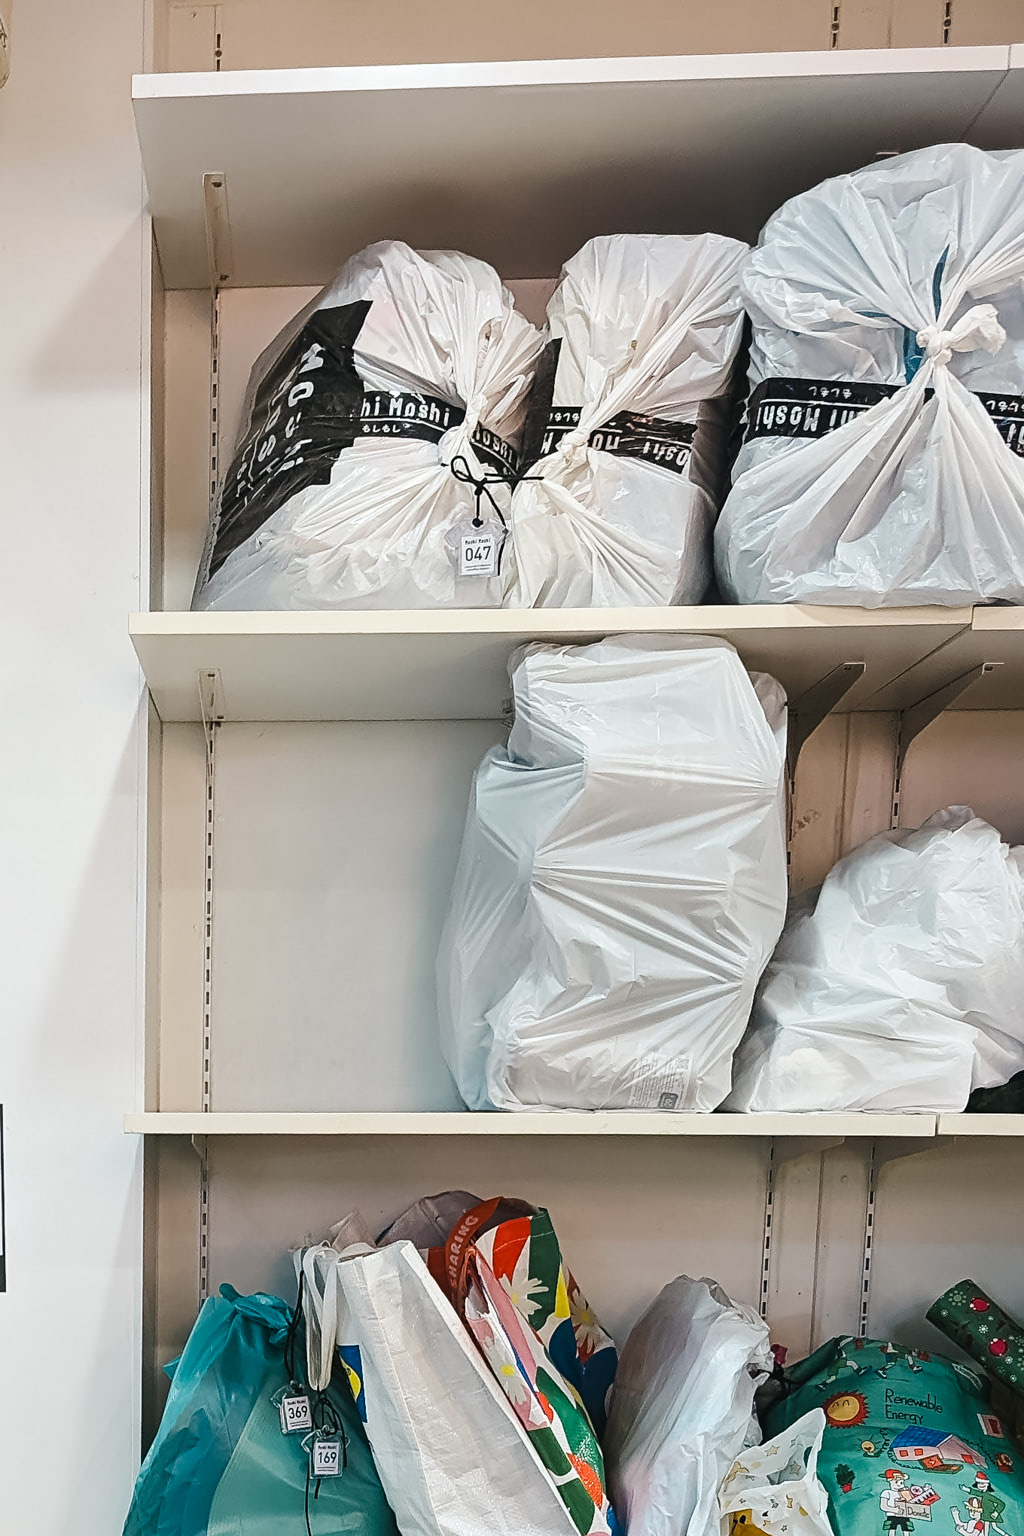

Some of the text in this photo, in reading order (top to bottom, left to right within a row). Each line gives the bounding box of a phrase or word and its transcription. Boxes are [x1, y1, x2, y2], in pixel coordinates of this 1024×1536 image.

[388, 397, 451, 427] Moshi
[465, 546, 492, 561] 047
[885, 1388, 943, 1413] Renewable
[288, 1405, 308, 1419] 369
[885, 1404, 923, 1425] Energy
[318, 1452, 337, 1464] 169
